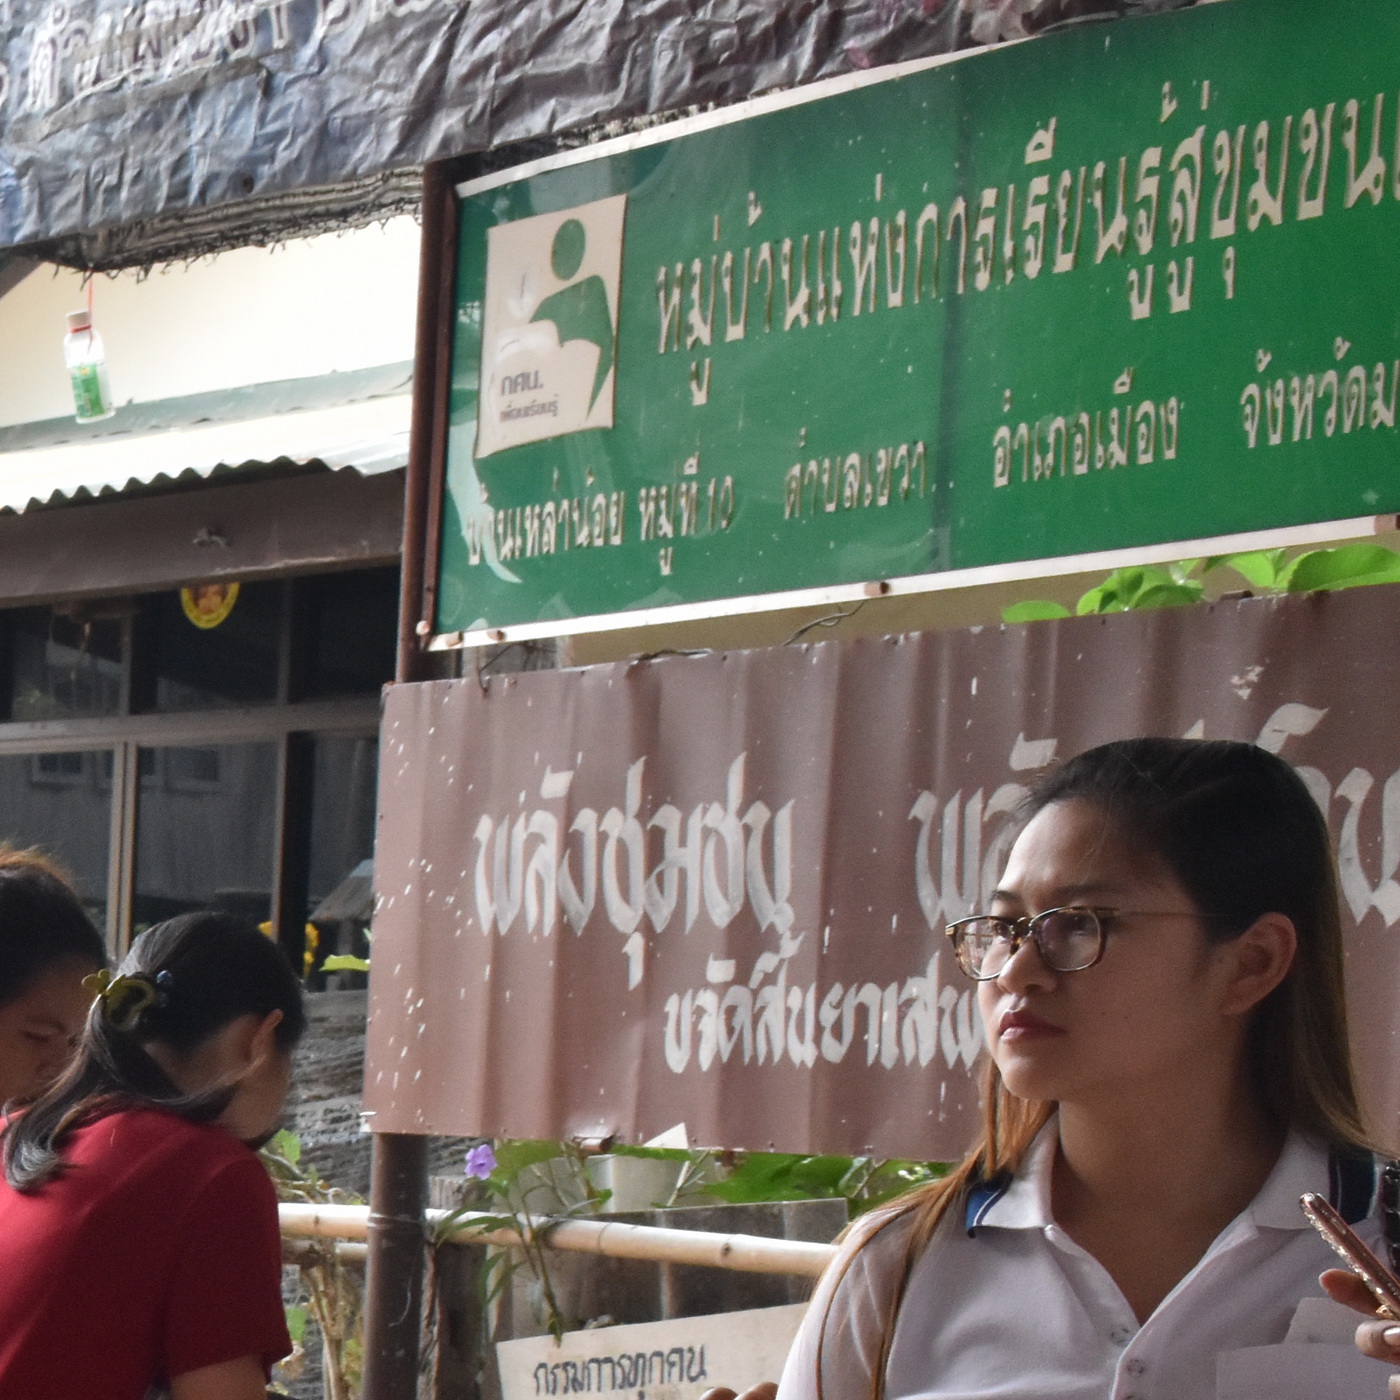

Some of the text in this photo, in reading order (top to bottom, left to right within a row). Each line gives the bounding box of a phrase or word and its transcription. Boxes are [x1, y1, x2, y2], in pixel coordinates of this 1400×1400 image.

[501, 370, 543, 396] กศน.
[992, 366, 1179, 488] อำเภอเมือง
[472, 750, 796, 992] พลังชุมชน
